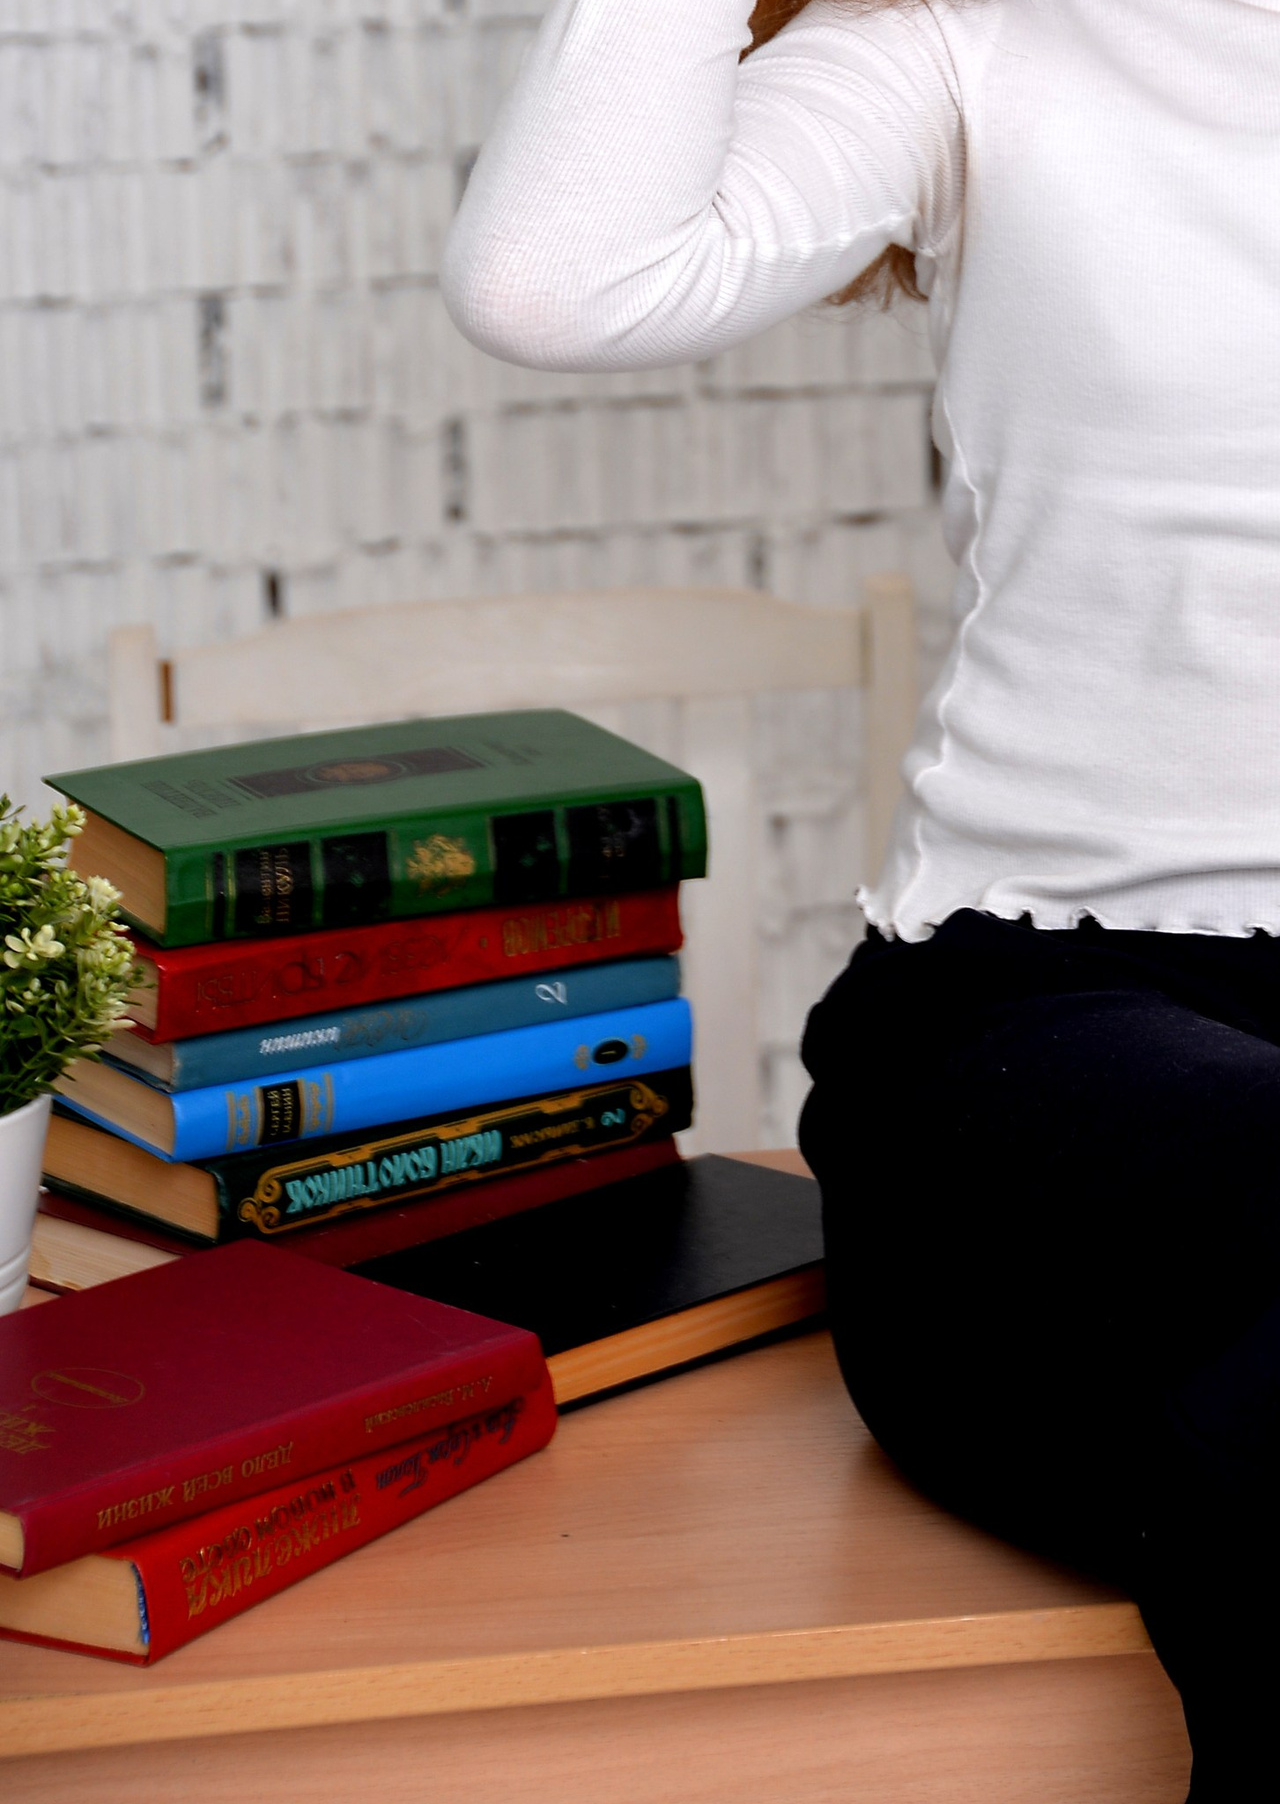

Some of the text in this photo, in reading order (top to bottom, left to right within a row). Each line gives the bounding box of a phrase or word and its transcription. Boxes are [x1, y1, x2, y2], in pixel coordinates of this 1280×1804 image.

[535, 981, 568, 1005] 2
[600, 1108, 626, 1128] 2
[97, 1441, 294, 1530] ДЕЛО ВСЕЙ ЖИЗНИ
